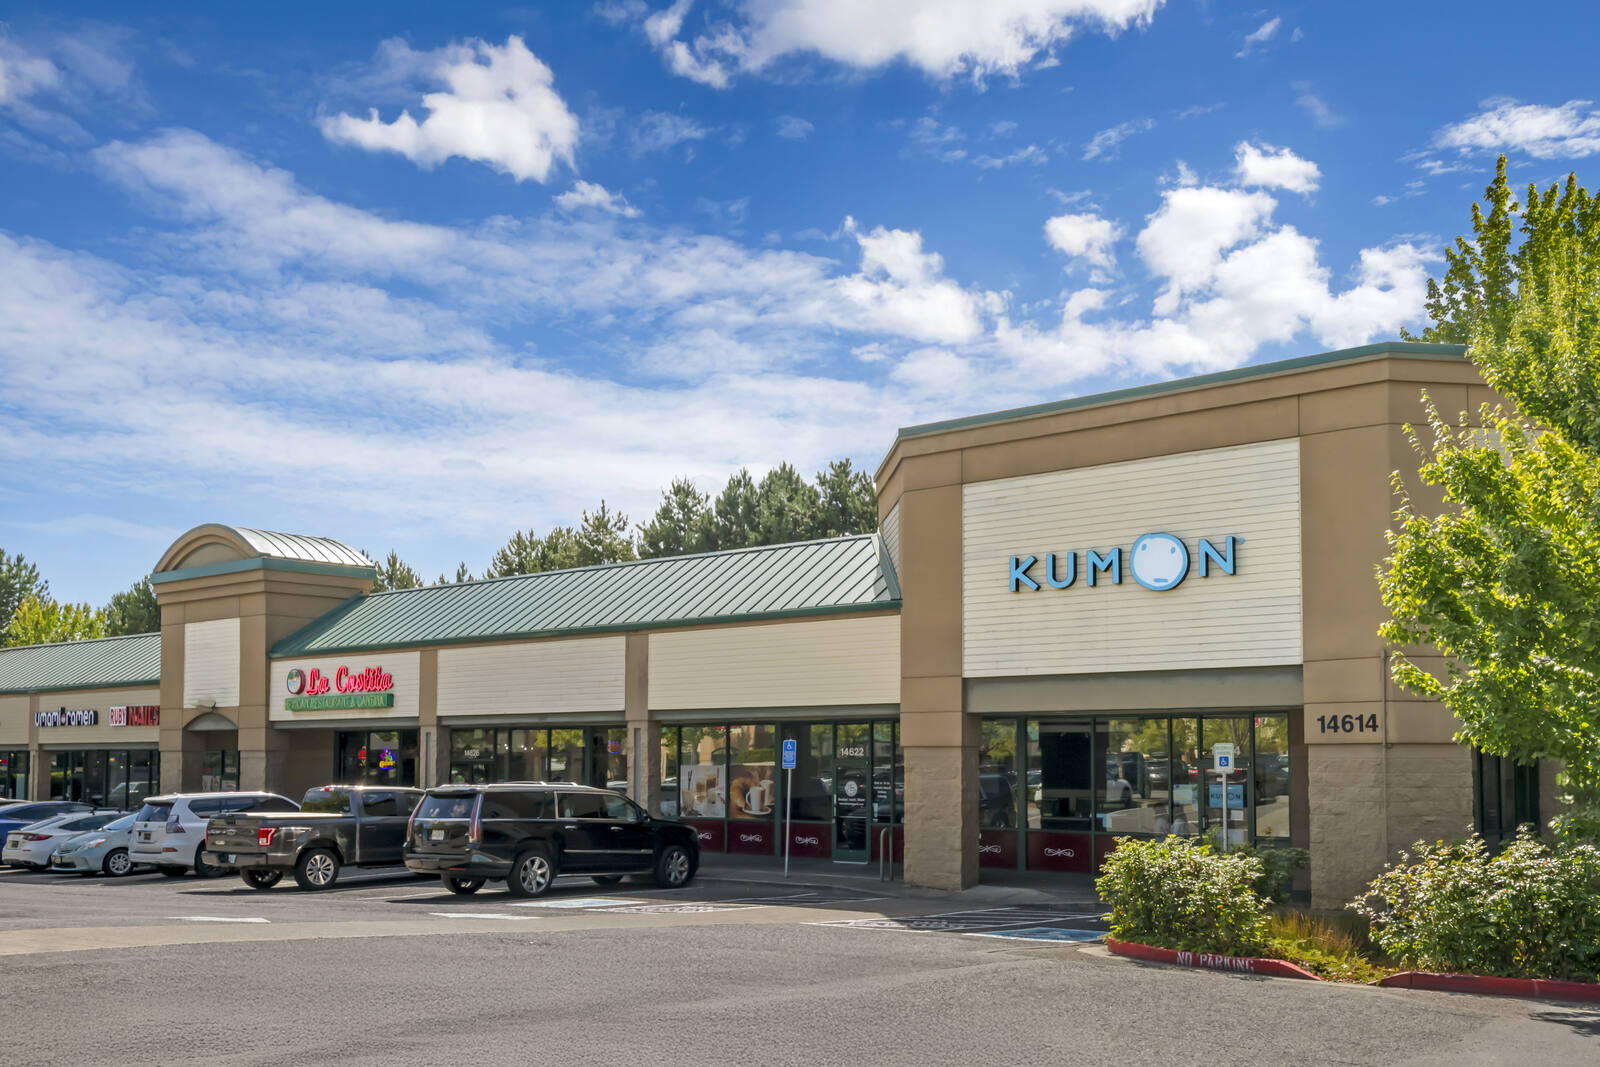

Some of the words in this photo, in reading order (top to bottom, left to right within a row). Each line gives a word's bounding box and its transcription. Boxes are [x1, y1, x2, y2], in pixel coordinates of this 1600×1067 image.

[1009, 532, 1237, 592] KUMON
[305, 668, 331, 695] La
[34, 711, 61, 727] umami
[65, 709, 96, 726] ramen
[110, 706, 126, 726] RUBY
[128, 705, 159, 726] NAILS
[1317, 713, 1379, 733] 14614
[840, 747, 865, 757] 14622
[1177, 951, 1192, 968] NO
[1200, 953, 1254, 974] PARKING
